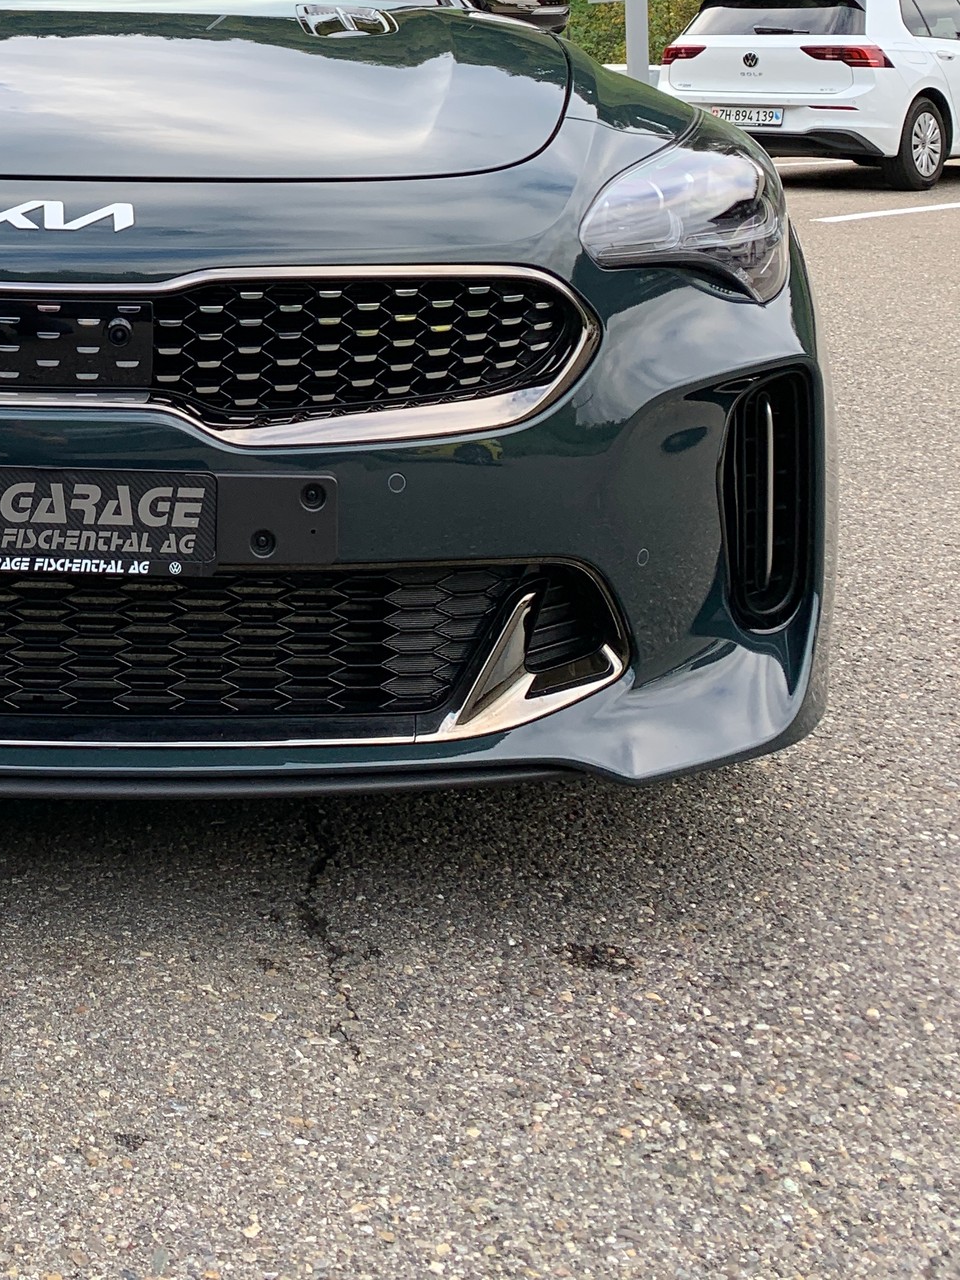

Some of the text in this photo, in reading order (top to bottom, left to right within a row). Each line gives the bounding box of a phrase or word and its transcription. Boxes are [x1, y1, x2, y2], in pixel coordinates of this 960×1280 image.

[0, 482, 206, 528] GARAGE
[1, 528, 197, 554] FISCHENTHAL AG
[34, 558, 125, 573] FISCHENTHAL
[128, 560, 150, 574] AG
